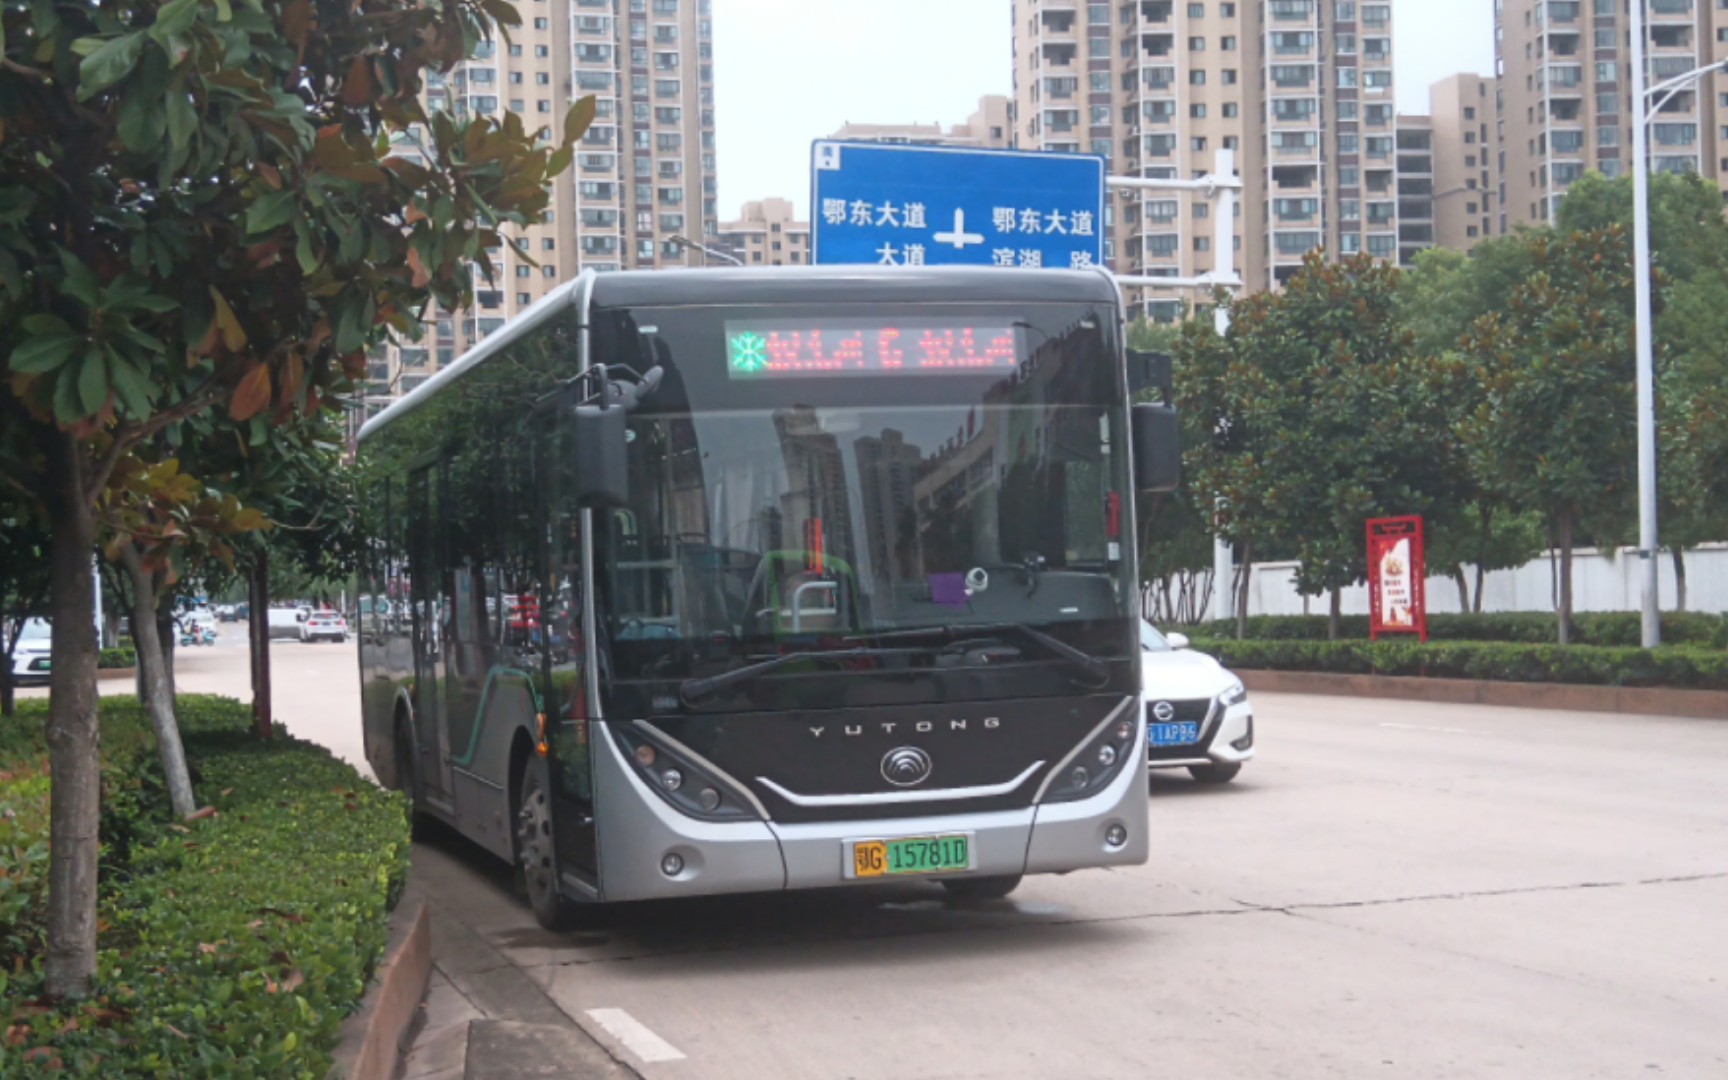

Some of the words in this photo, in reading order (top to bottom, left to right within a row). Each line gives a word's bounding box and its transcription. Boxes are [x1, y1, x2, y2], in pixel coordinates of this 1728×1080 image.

[822, 198, 927, 228] 鄂东大道
[992, 207, 1094, 236] 鄂东大道
[810, 717, 1000, 737] YUTONG
